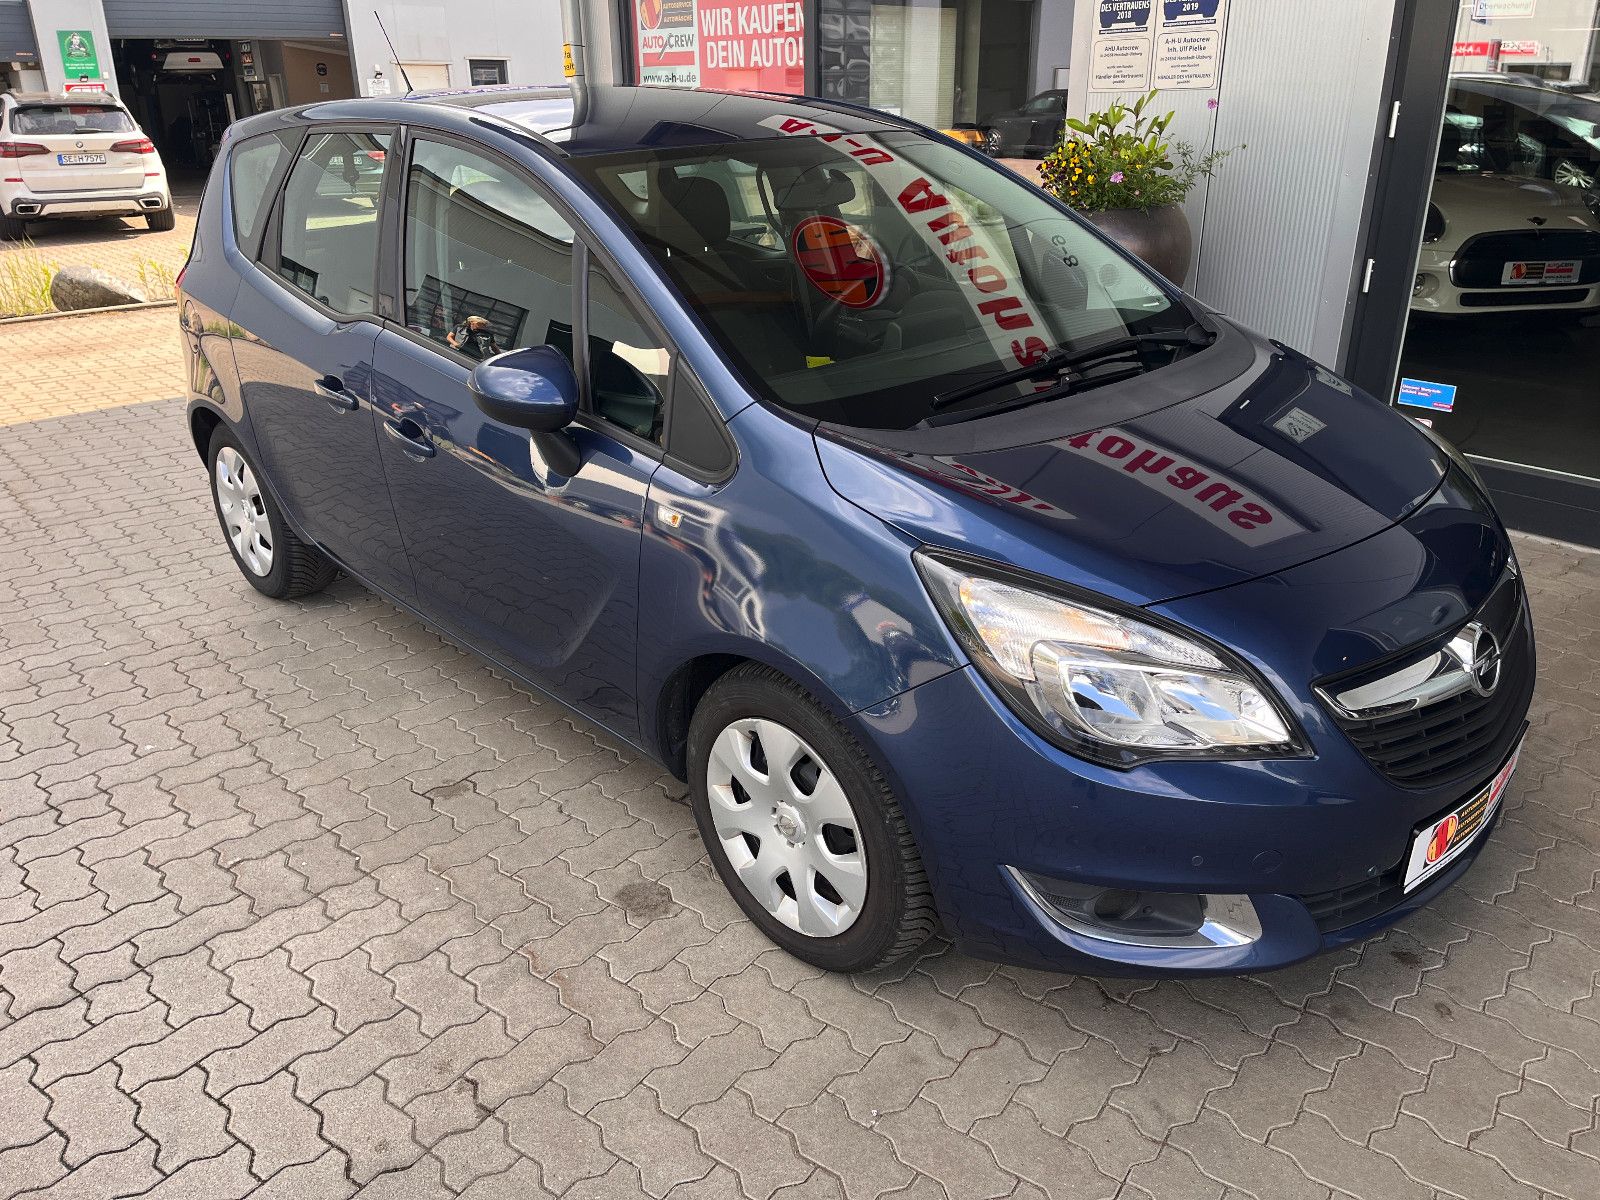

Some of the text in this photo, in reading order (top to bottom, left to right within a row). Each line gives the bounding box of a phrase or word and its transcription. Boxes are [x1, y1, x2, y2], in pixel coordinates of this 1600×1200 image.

[1101, 1, 1150, 12] DES VERTRAUENS
[1182, 2, 1199, 12] 2019
[1116, 10, 1132, 20] 2018
[700, 7, 737, 37] WIR
[1182, 36, 1210, 44] Autocrew
[706, 36, 804, 69] DEIN AUTO!
[643, 70, 697, 84] www.a-h-u.de
[63, 154, 74, 163] SE
